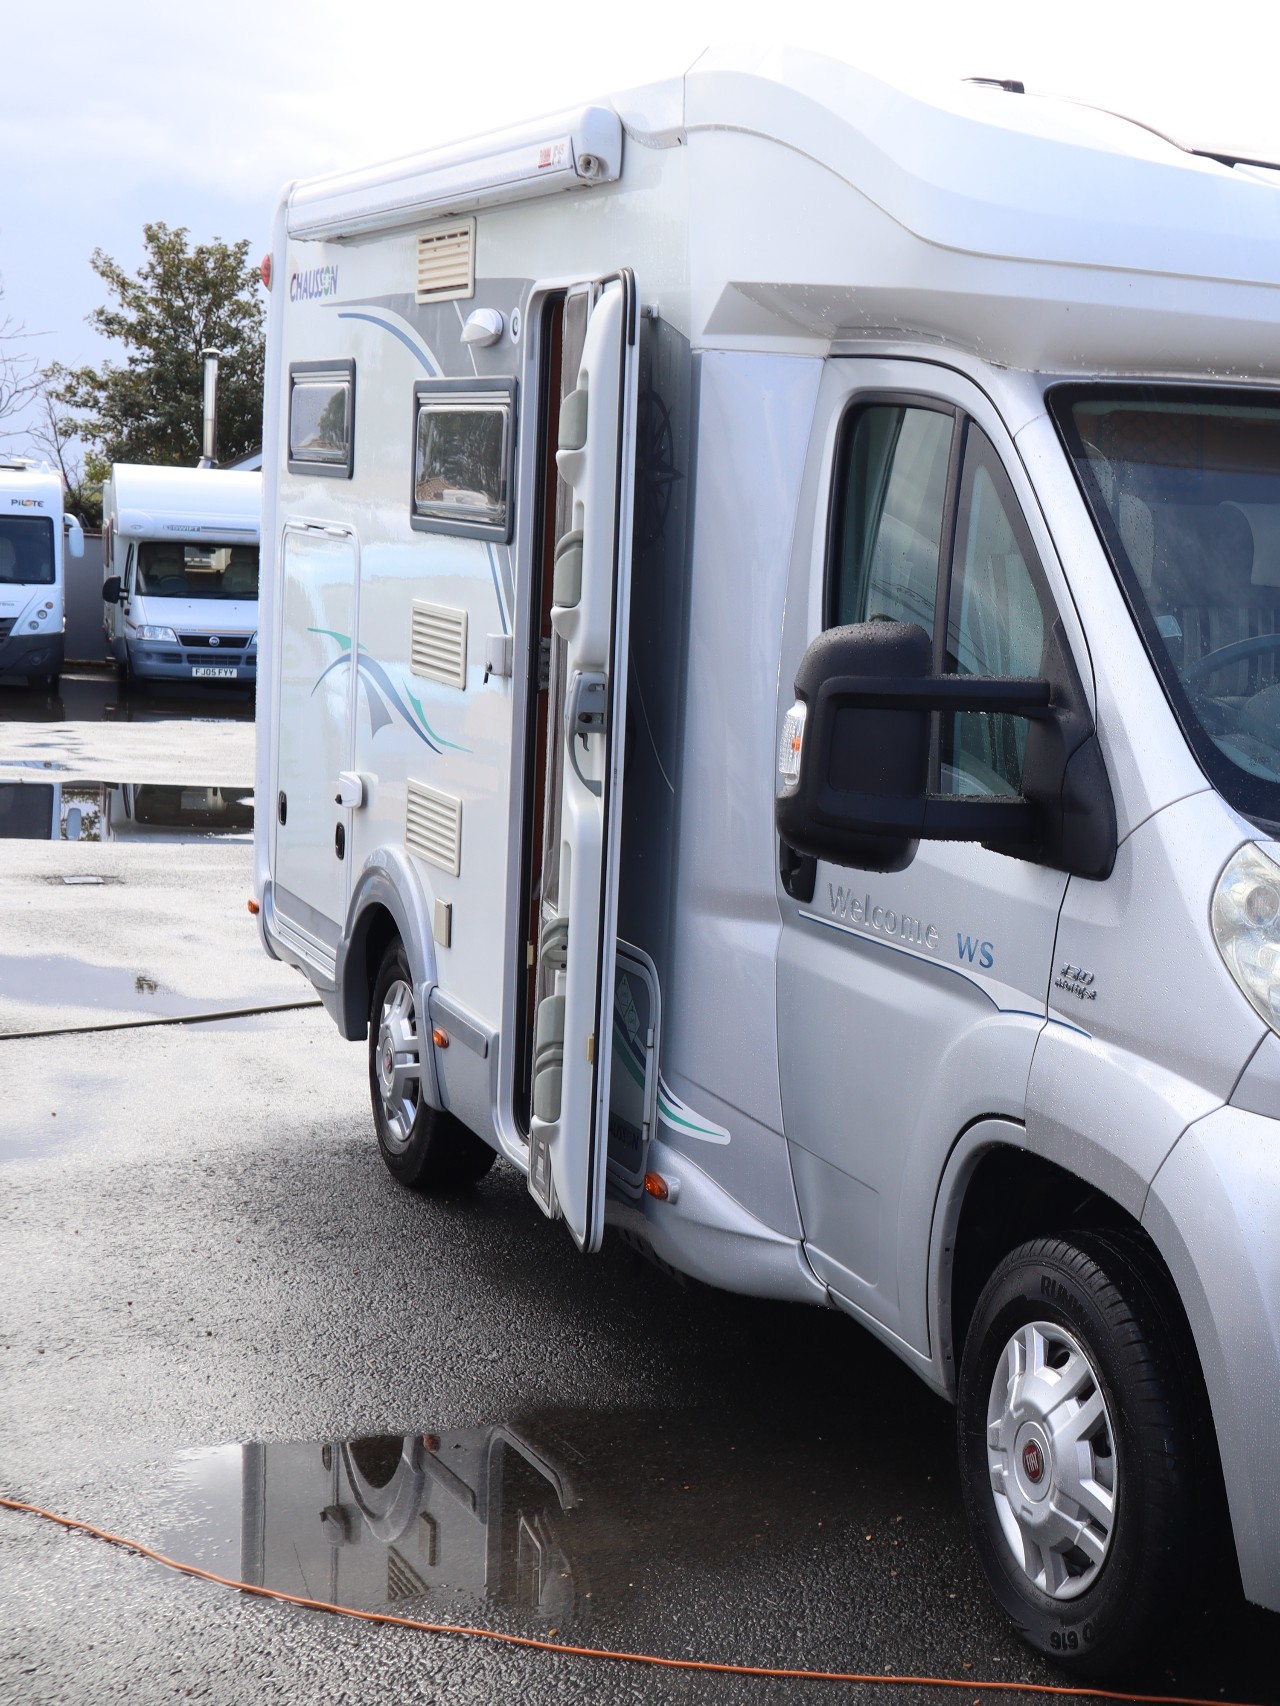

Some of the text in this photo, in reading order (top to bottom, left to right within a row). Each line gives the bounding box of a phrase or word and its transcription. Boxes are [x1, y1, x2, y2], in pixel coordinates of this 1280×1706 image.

[290, 264, 339, 303] CHAUSSON
[828, 882, 994, 969] Welcome WS
